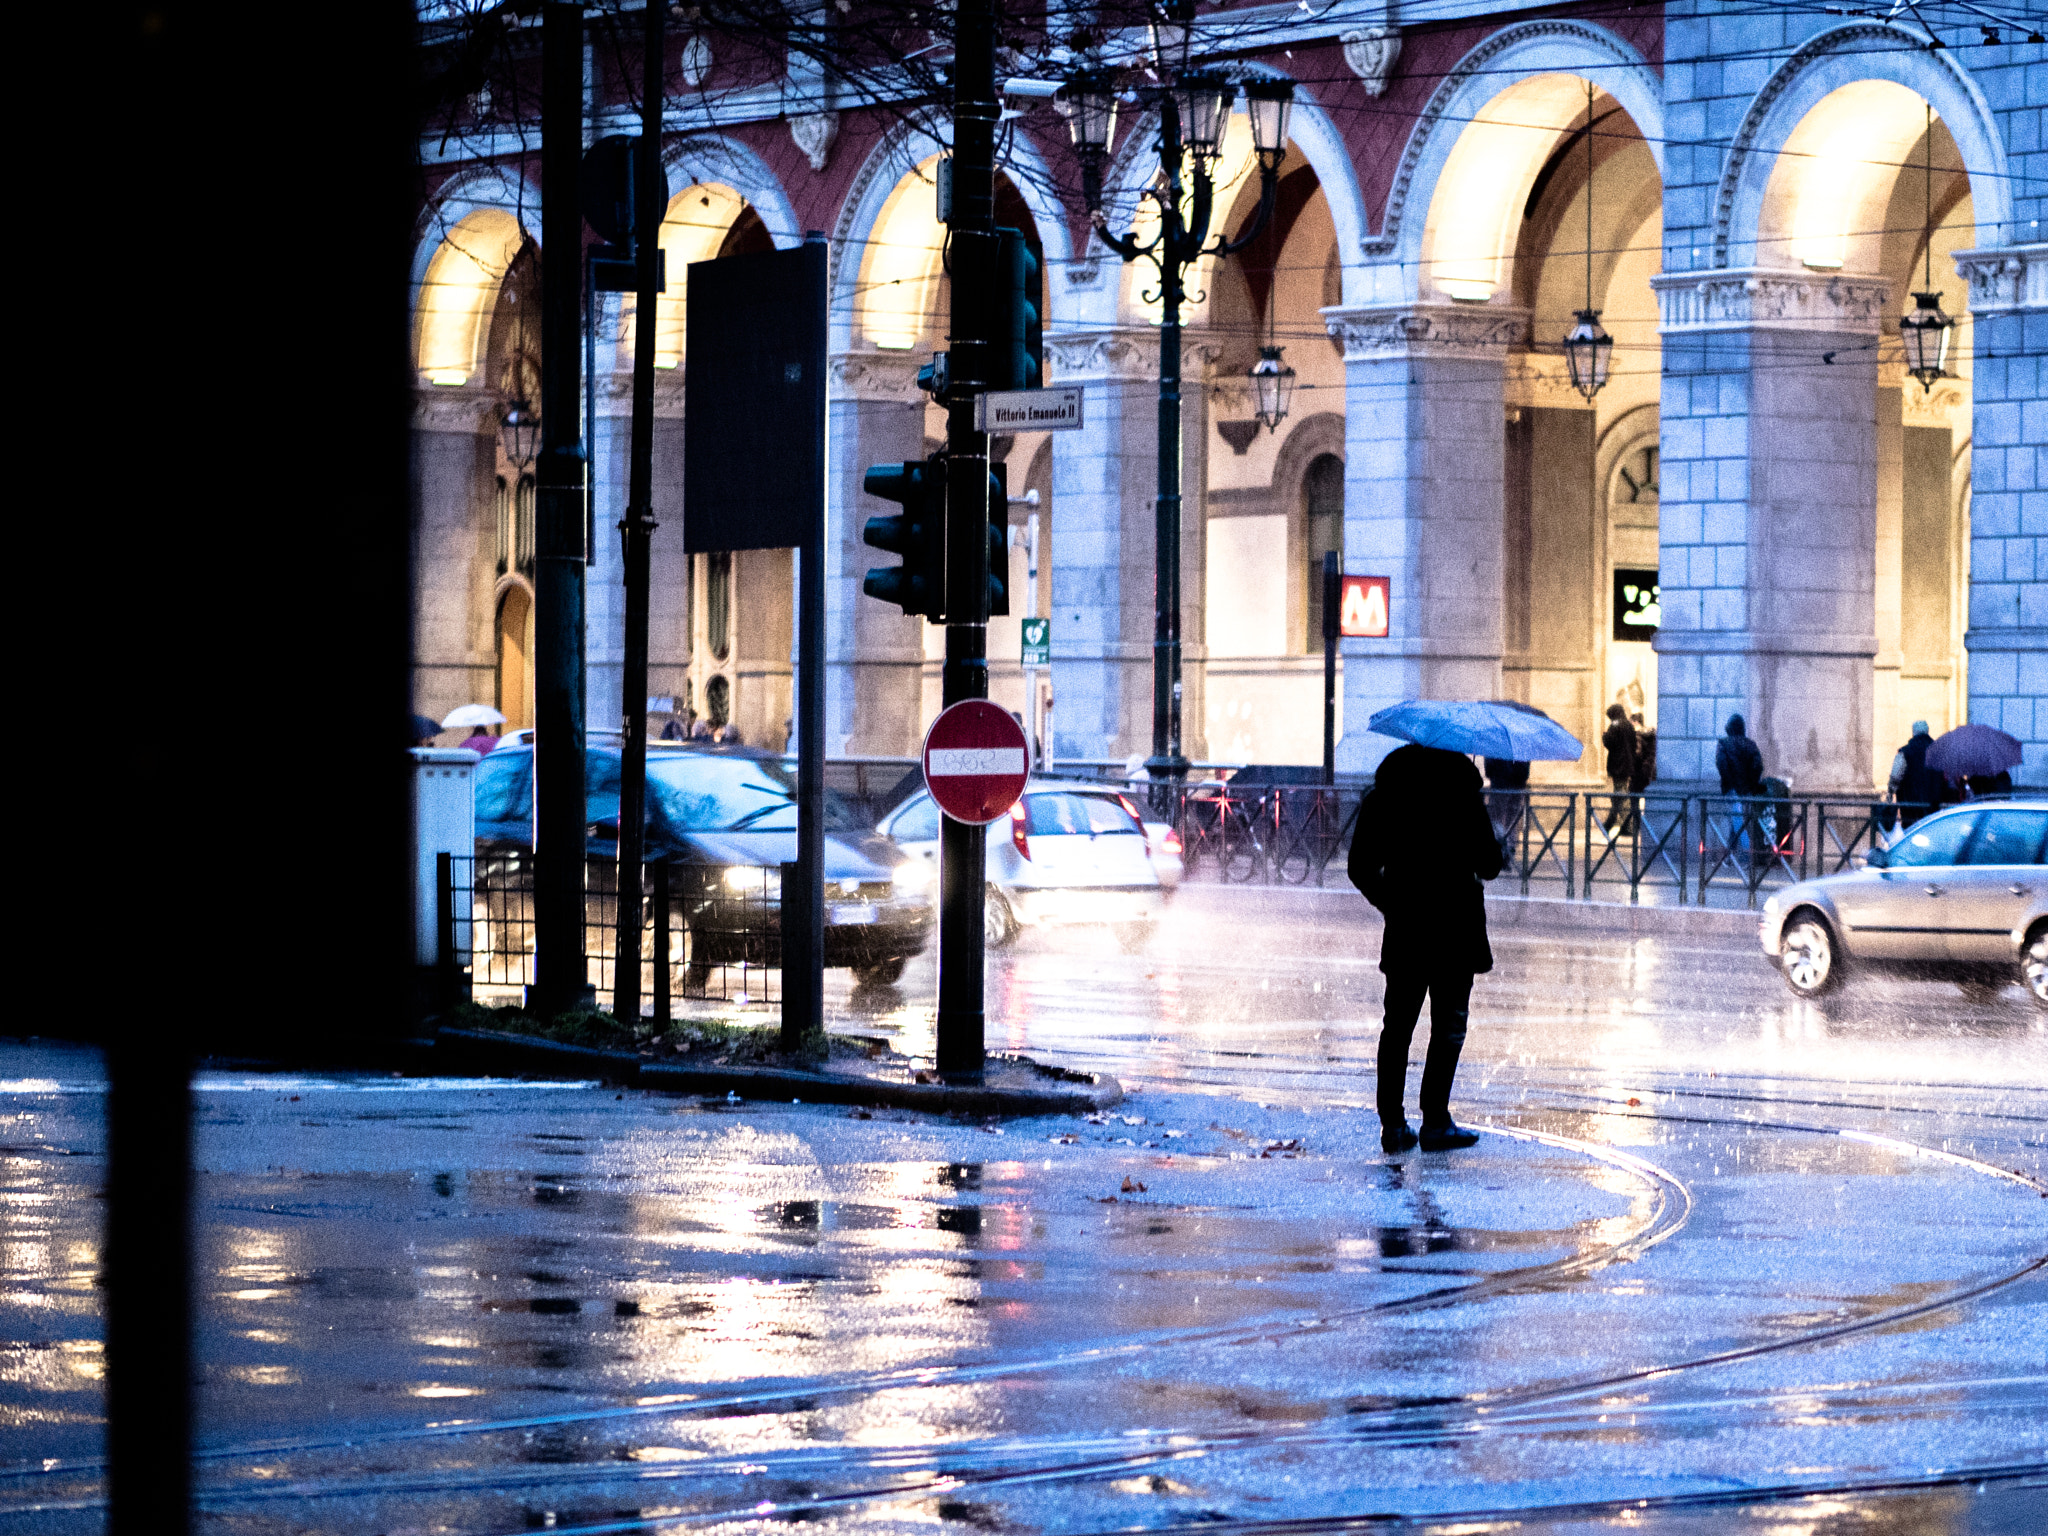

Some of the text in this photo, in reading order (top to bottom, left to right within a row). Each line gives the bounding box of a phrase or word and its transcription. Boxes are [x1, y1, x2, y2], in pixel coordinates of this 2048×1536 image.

[996, 404, 1075, 421] Vittorio Emanuele II
[1342, 585, 1387, 628] M
